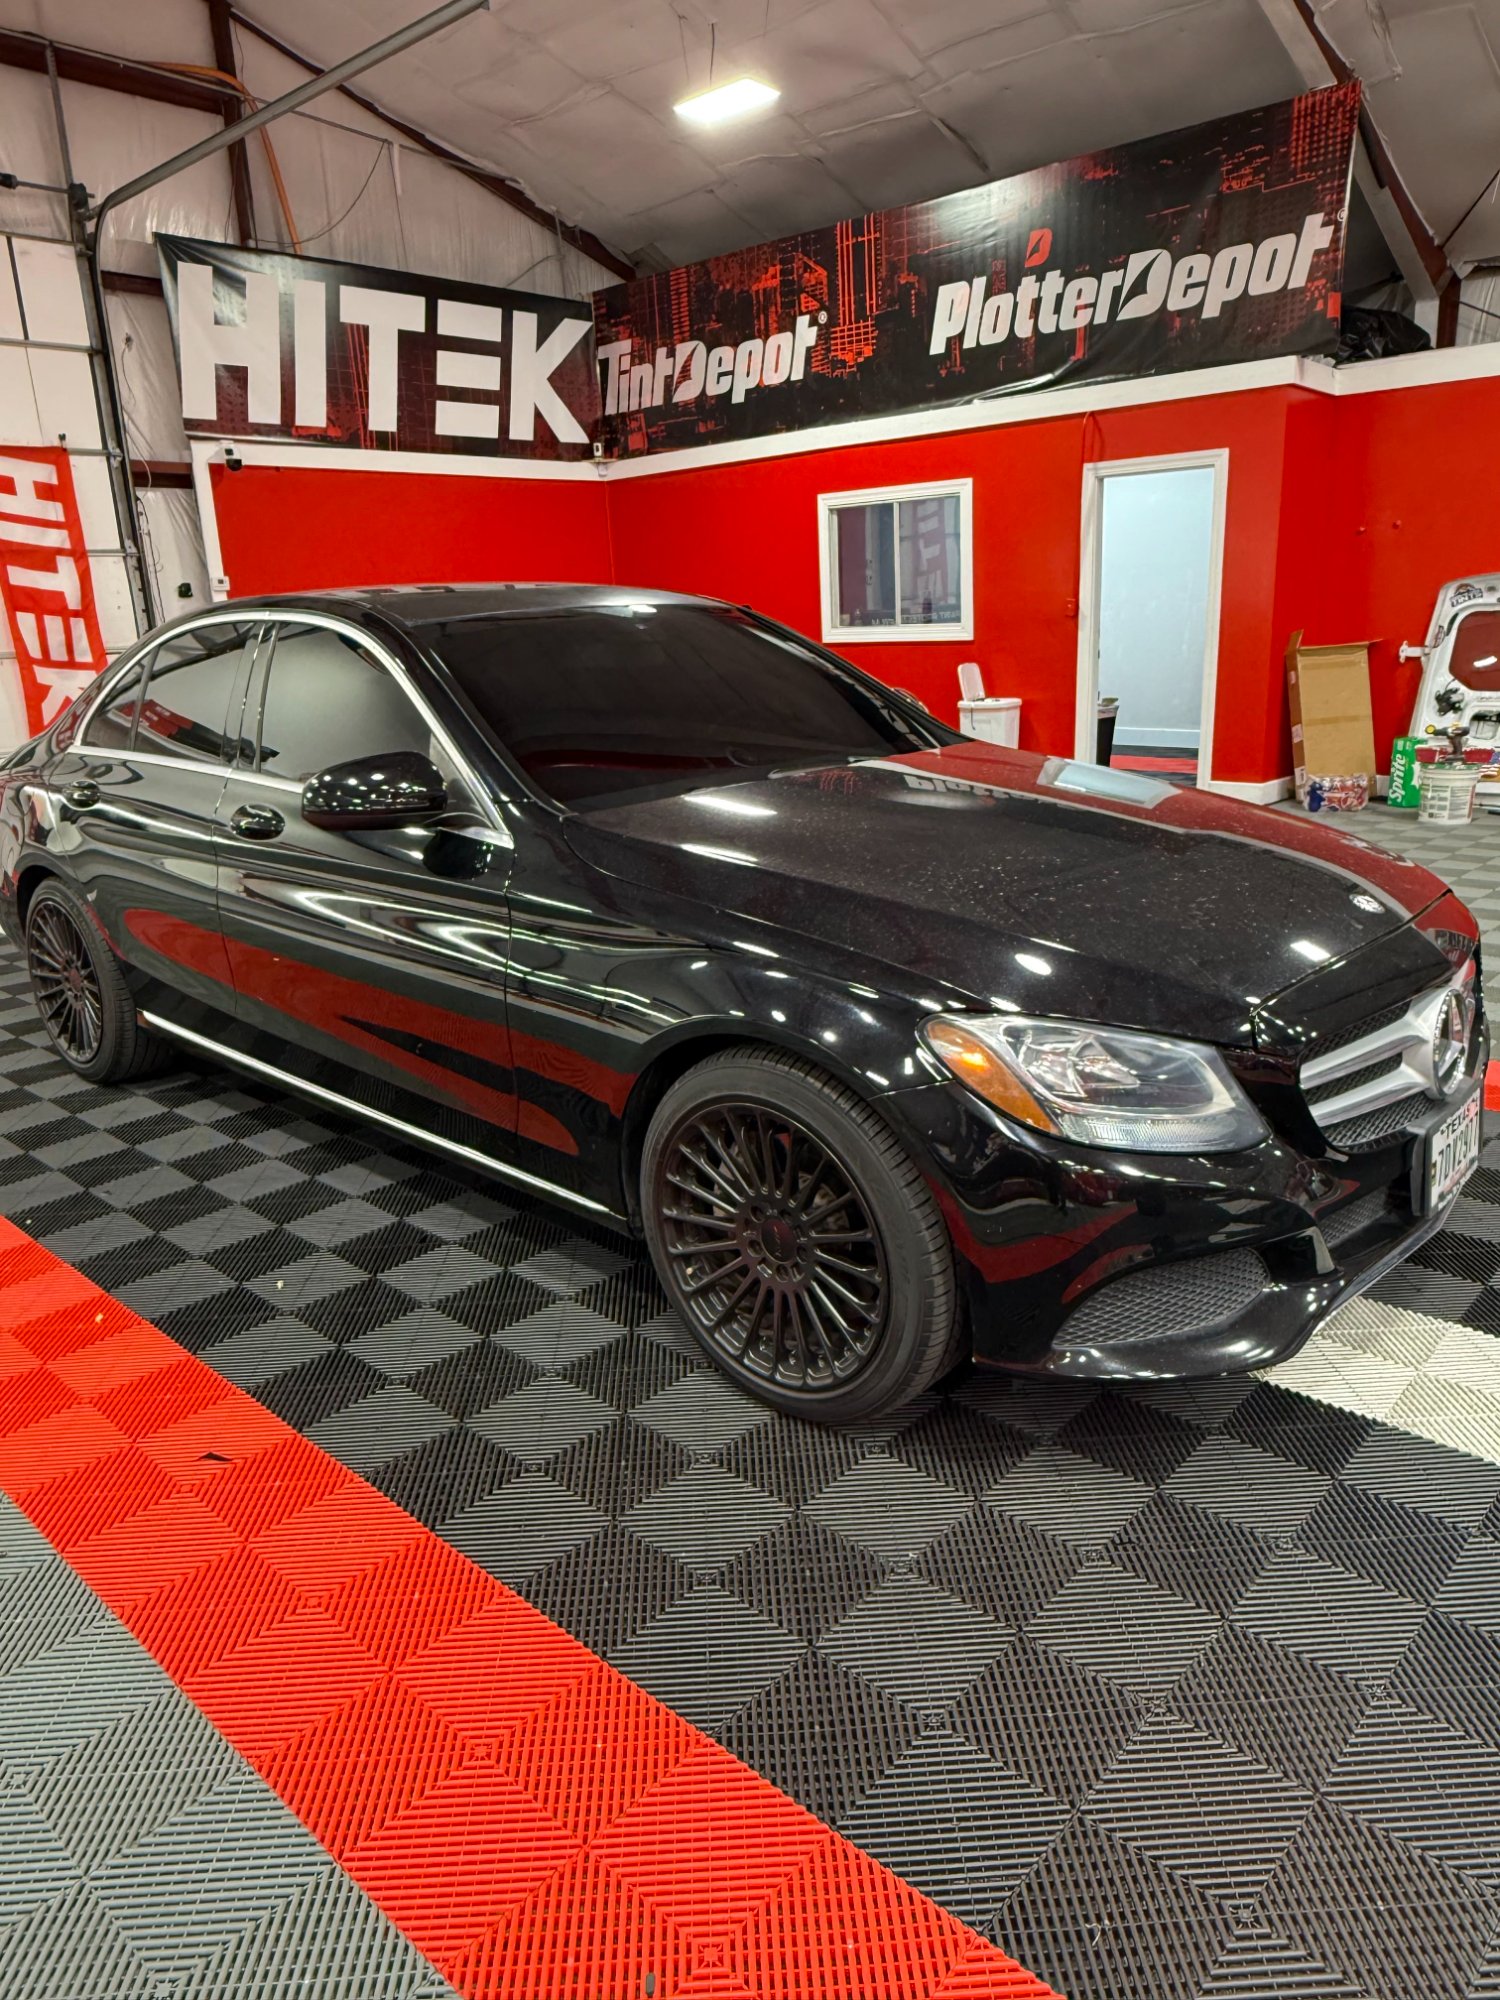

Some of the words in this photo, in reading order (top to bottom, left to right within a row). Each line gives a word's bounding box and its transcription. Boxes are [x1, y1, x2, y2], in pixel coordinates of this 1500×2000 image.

[178, 261, 592, 443] HITEK
[929, 211, 1335, 355] PlotterDepot
[597, 315, 819, 416] TintDepot
[0, 456, 98, 726] HITEK
[1389, 753, 1406, 803] Sprite
